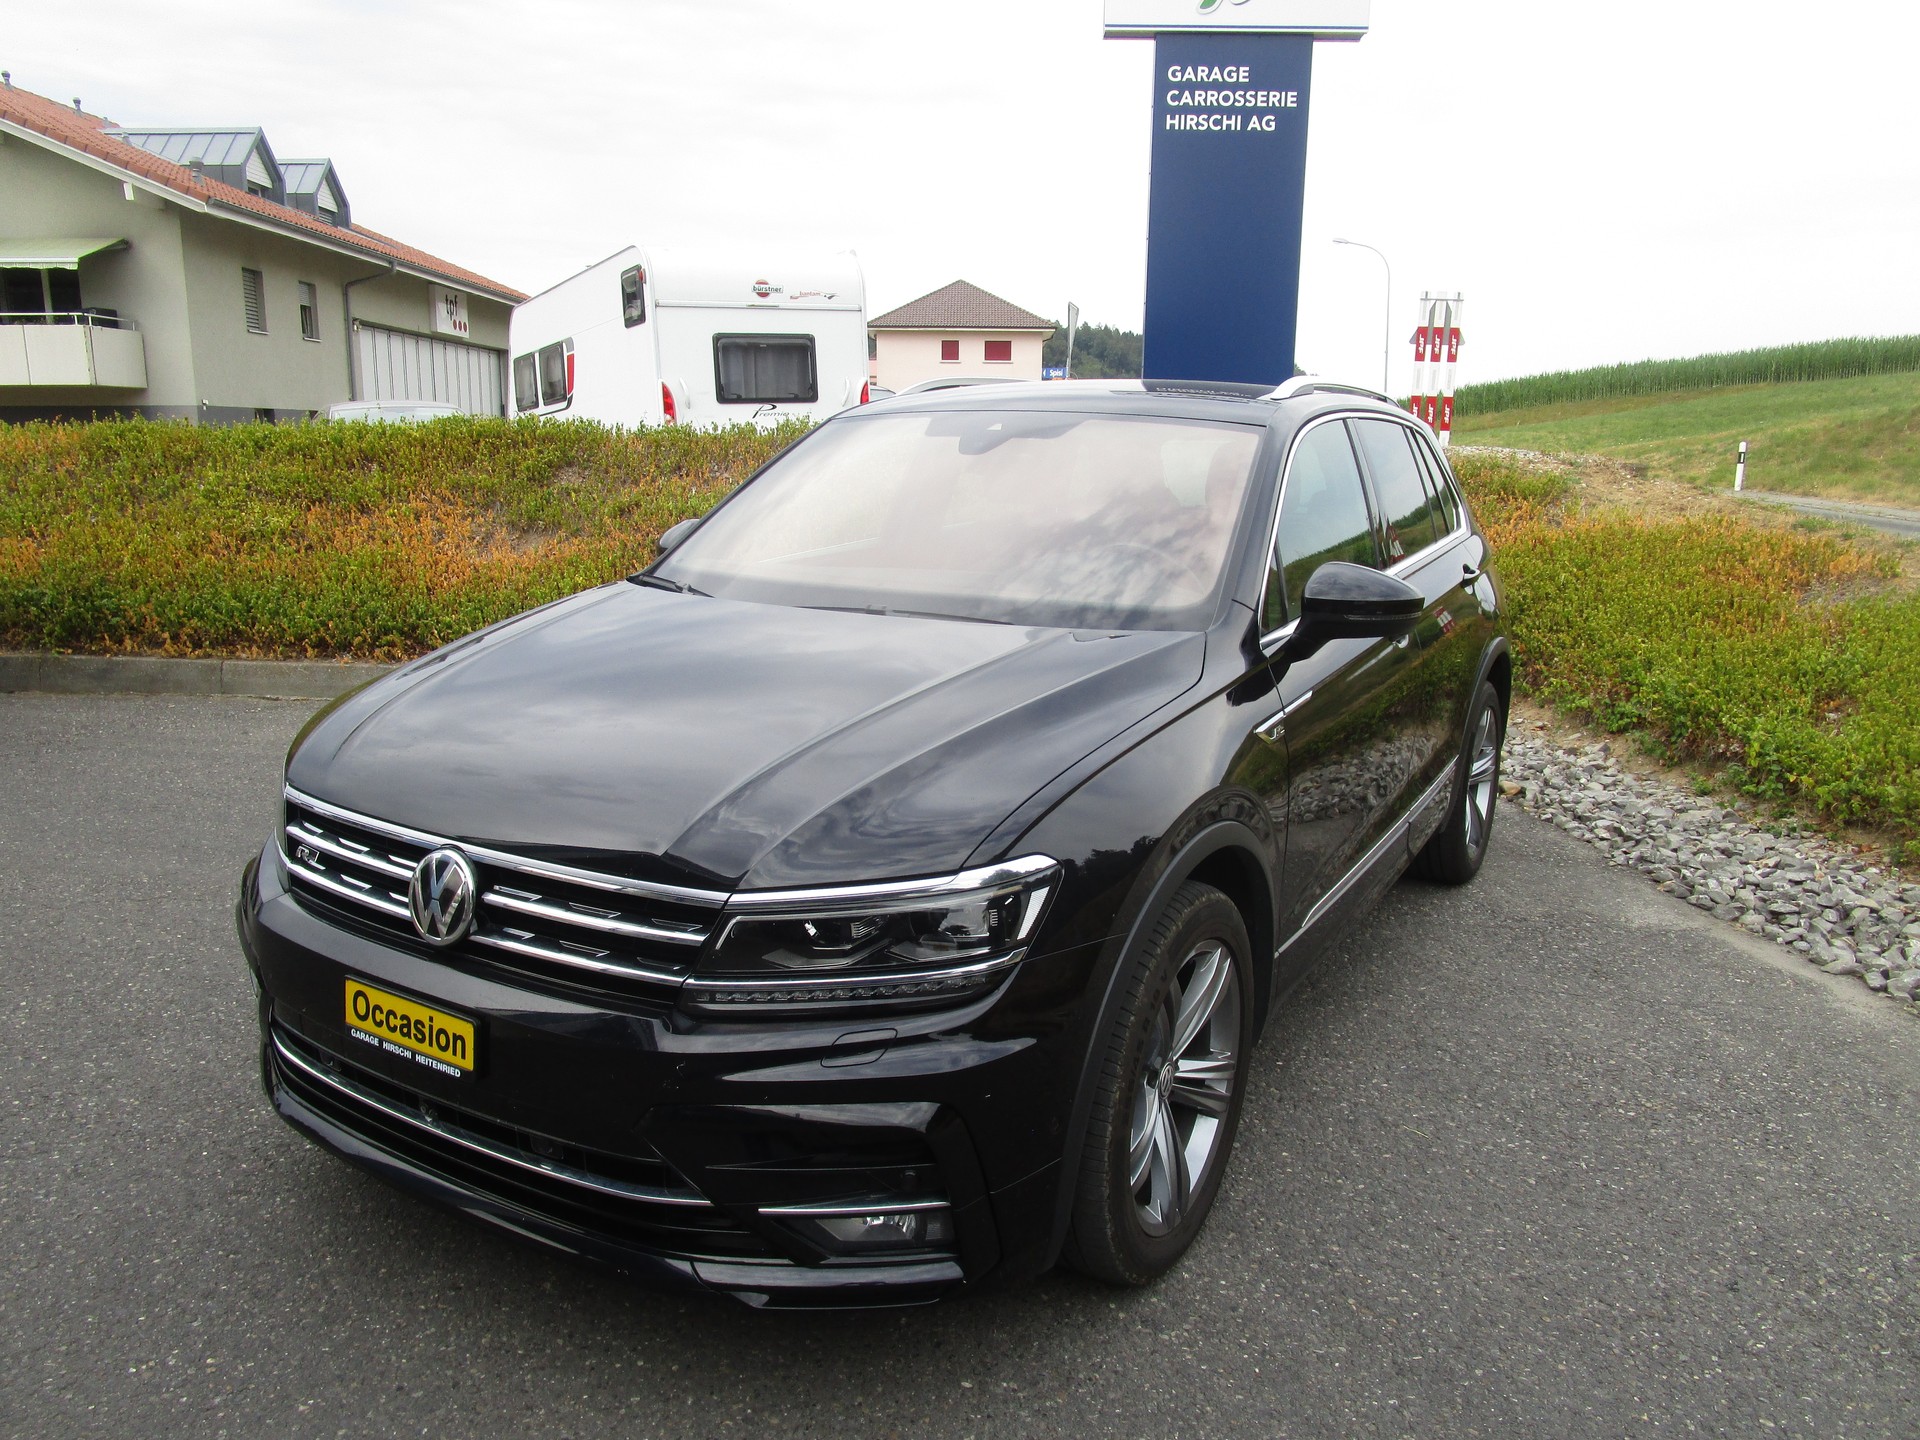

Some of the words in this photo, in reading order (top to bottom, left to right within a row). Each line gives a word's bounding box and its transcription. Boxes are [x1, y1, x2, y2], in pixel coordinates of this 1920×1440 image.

[1167, 65, 1250, 83] GARAGE
[1166, 89, 1298, 108] CARROSSERIE
[1165, 114, 1241, 131] HIRSCHI
[1247, 115, 1276, 132] AG
[752, 284, 782, 293] bürstner
[445, 294, 458, 321] tpf
[352, 989, 467, 1060] Occasion
[350, 1028, 379, 1047] GARAGE
[382, 1041, 412, 1059] HIRSCHI
[415, 1054, 461, 1078] HEITENRIED
